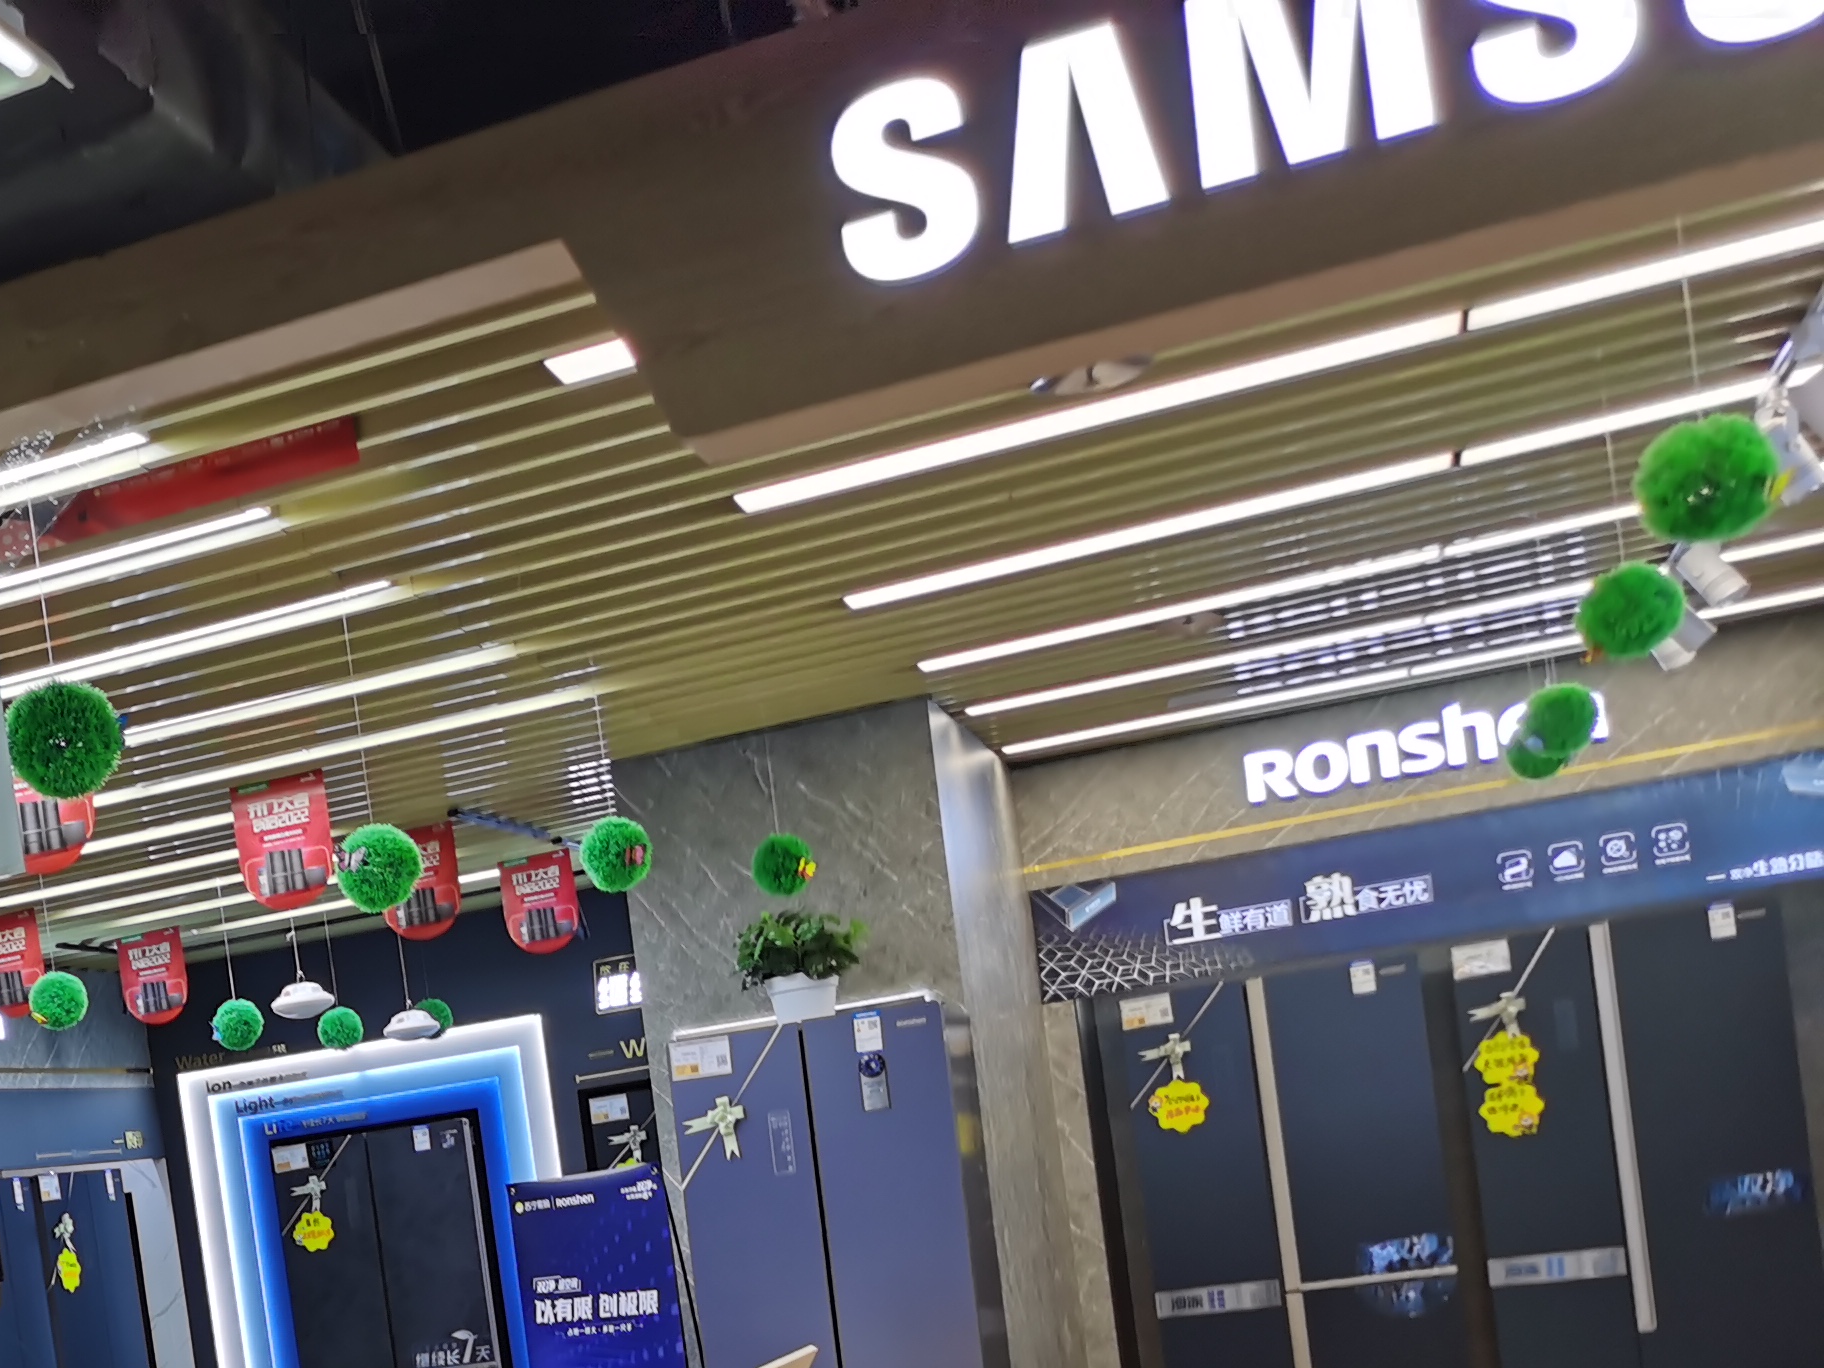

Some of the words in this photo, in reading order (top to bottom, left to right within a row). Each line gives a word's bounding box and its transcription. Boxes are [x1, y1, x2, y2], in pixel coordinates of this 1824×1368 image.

[829, 0, 1824, 286] SAMS
[1243, 690, 1610, 808] Ronsh
[1169, 895, 1291, 945] 生鲜有道
[1304, 871, 1430, 924] 熟食无忧
[533, 1294, 594, 1325] 以有限
[598, 1289, 659, 1319] 创极限
